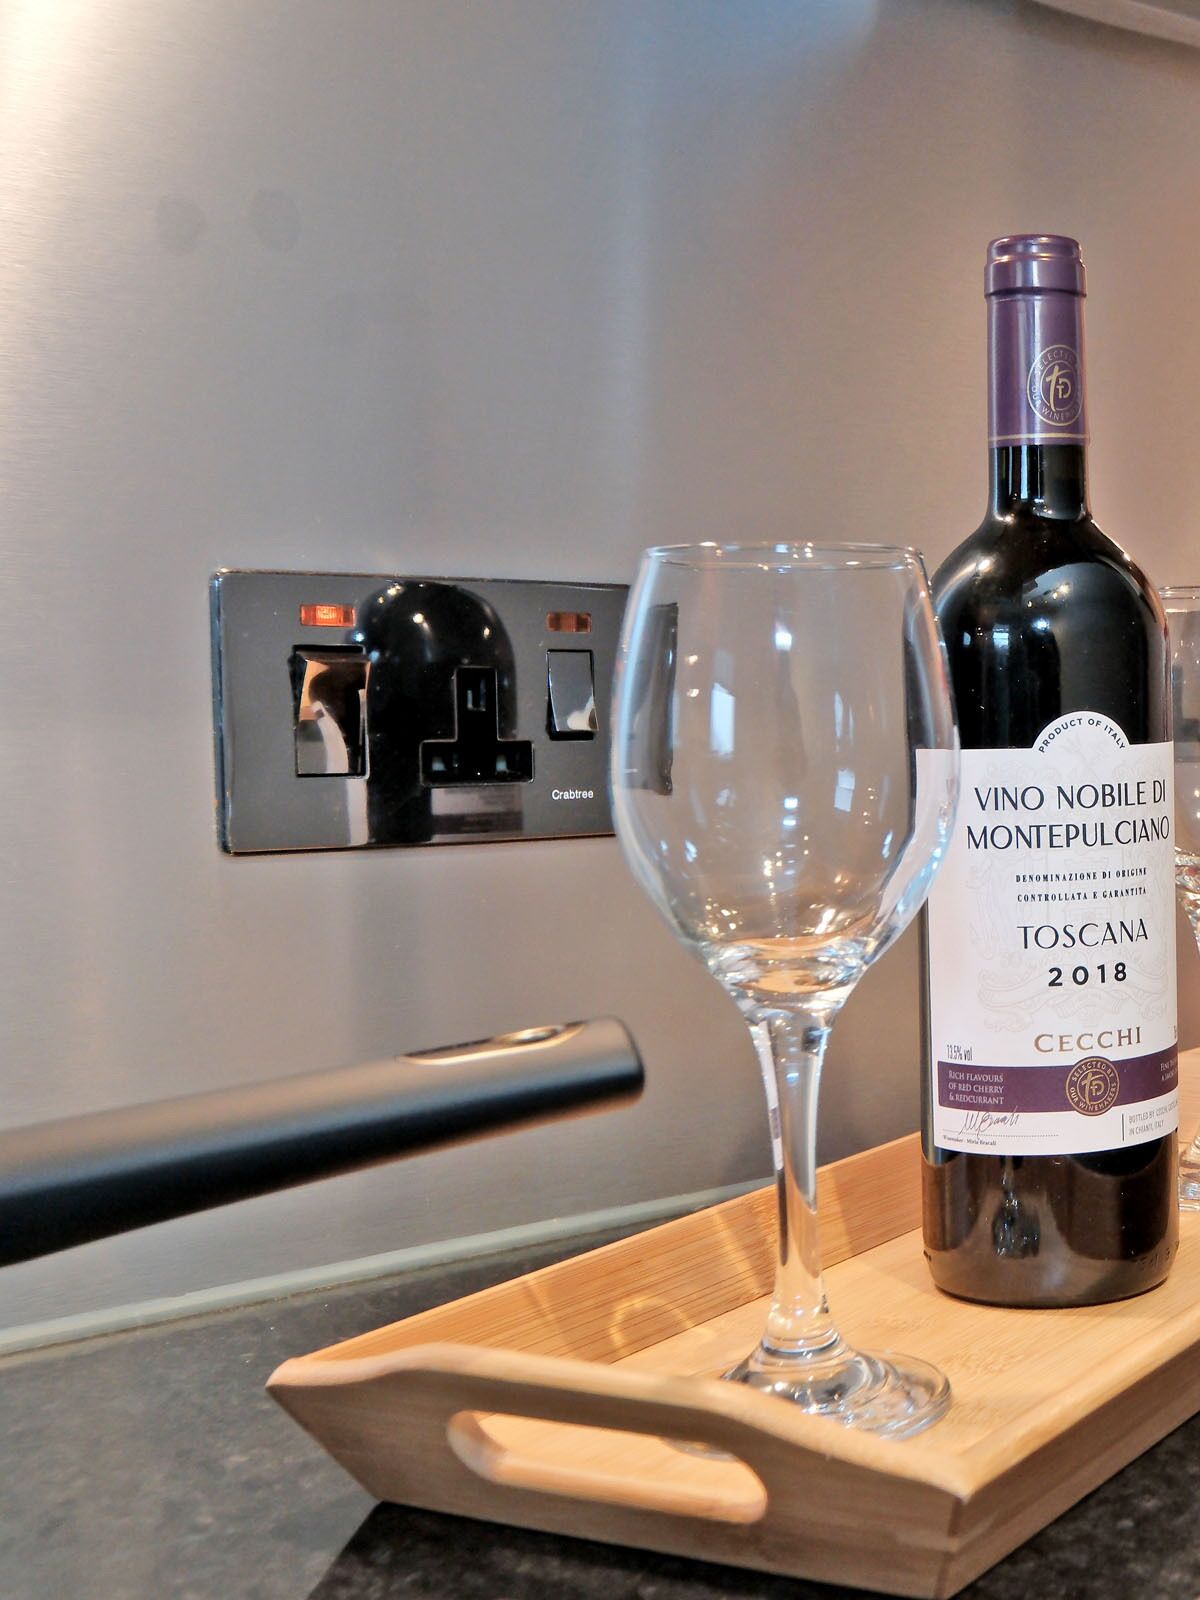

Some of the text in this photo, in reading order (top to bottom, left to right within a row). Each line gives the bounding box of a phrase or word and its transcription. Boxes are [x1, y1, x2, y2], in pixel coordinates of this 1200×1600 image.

[1038, 717, 1126, 753] PRODUCT OF ITALY
[551, 789, 594, 800] Crabtree
[974, 778, 1166, 811] VINO NOBILE DI
[966, 815, 1171, 850] MONTEPULCIANO
[1015, 867, 1147, 883] DENOMINAZIONE DI ORIGINE
[1017, 886, 1147, 903] CONTROLLATA E GARANTITA
[1016, 918, 1149, 950] TOSCANA
[1047, 962, 1128, 988] 2018
[1033, 1026, 1142, 1053] CECCHI
[963, 1046, 973, 1061] vol
[948, 1070, 1004, 1083] RICH FLAVOURS
[1071, 1061, 1107, 1082] SELECTED
[948, 1082, 1005, 1094] OF RED CHERRY
[1070, 1082, 1117, 1111] OUR WINEMAKERS
[955, 1093, 1005, 1105] REDCURRANT
